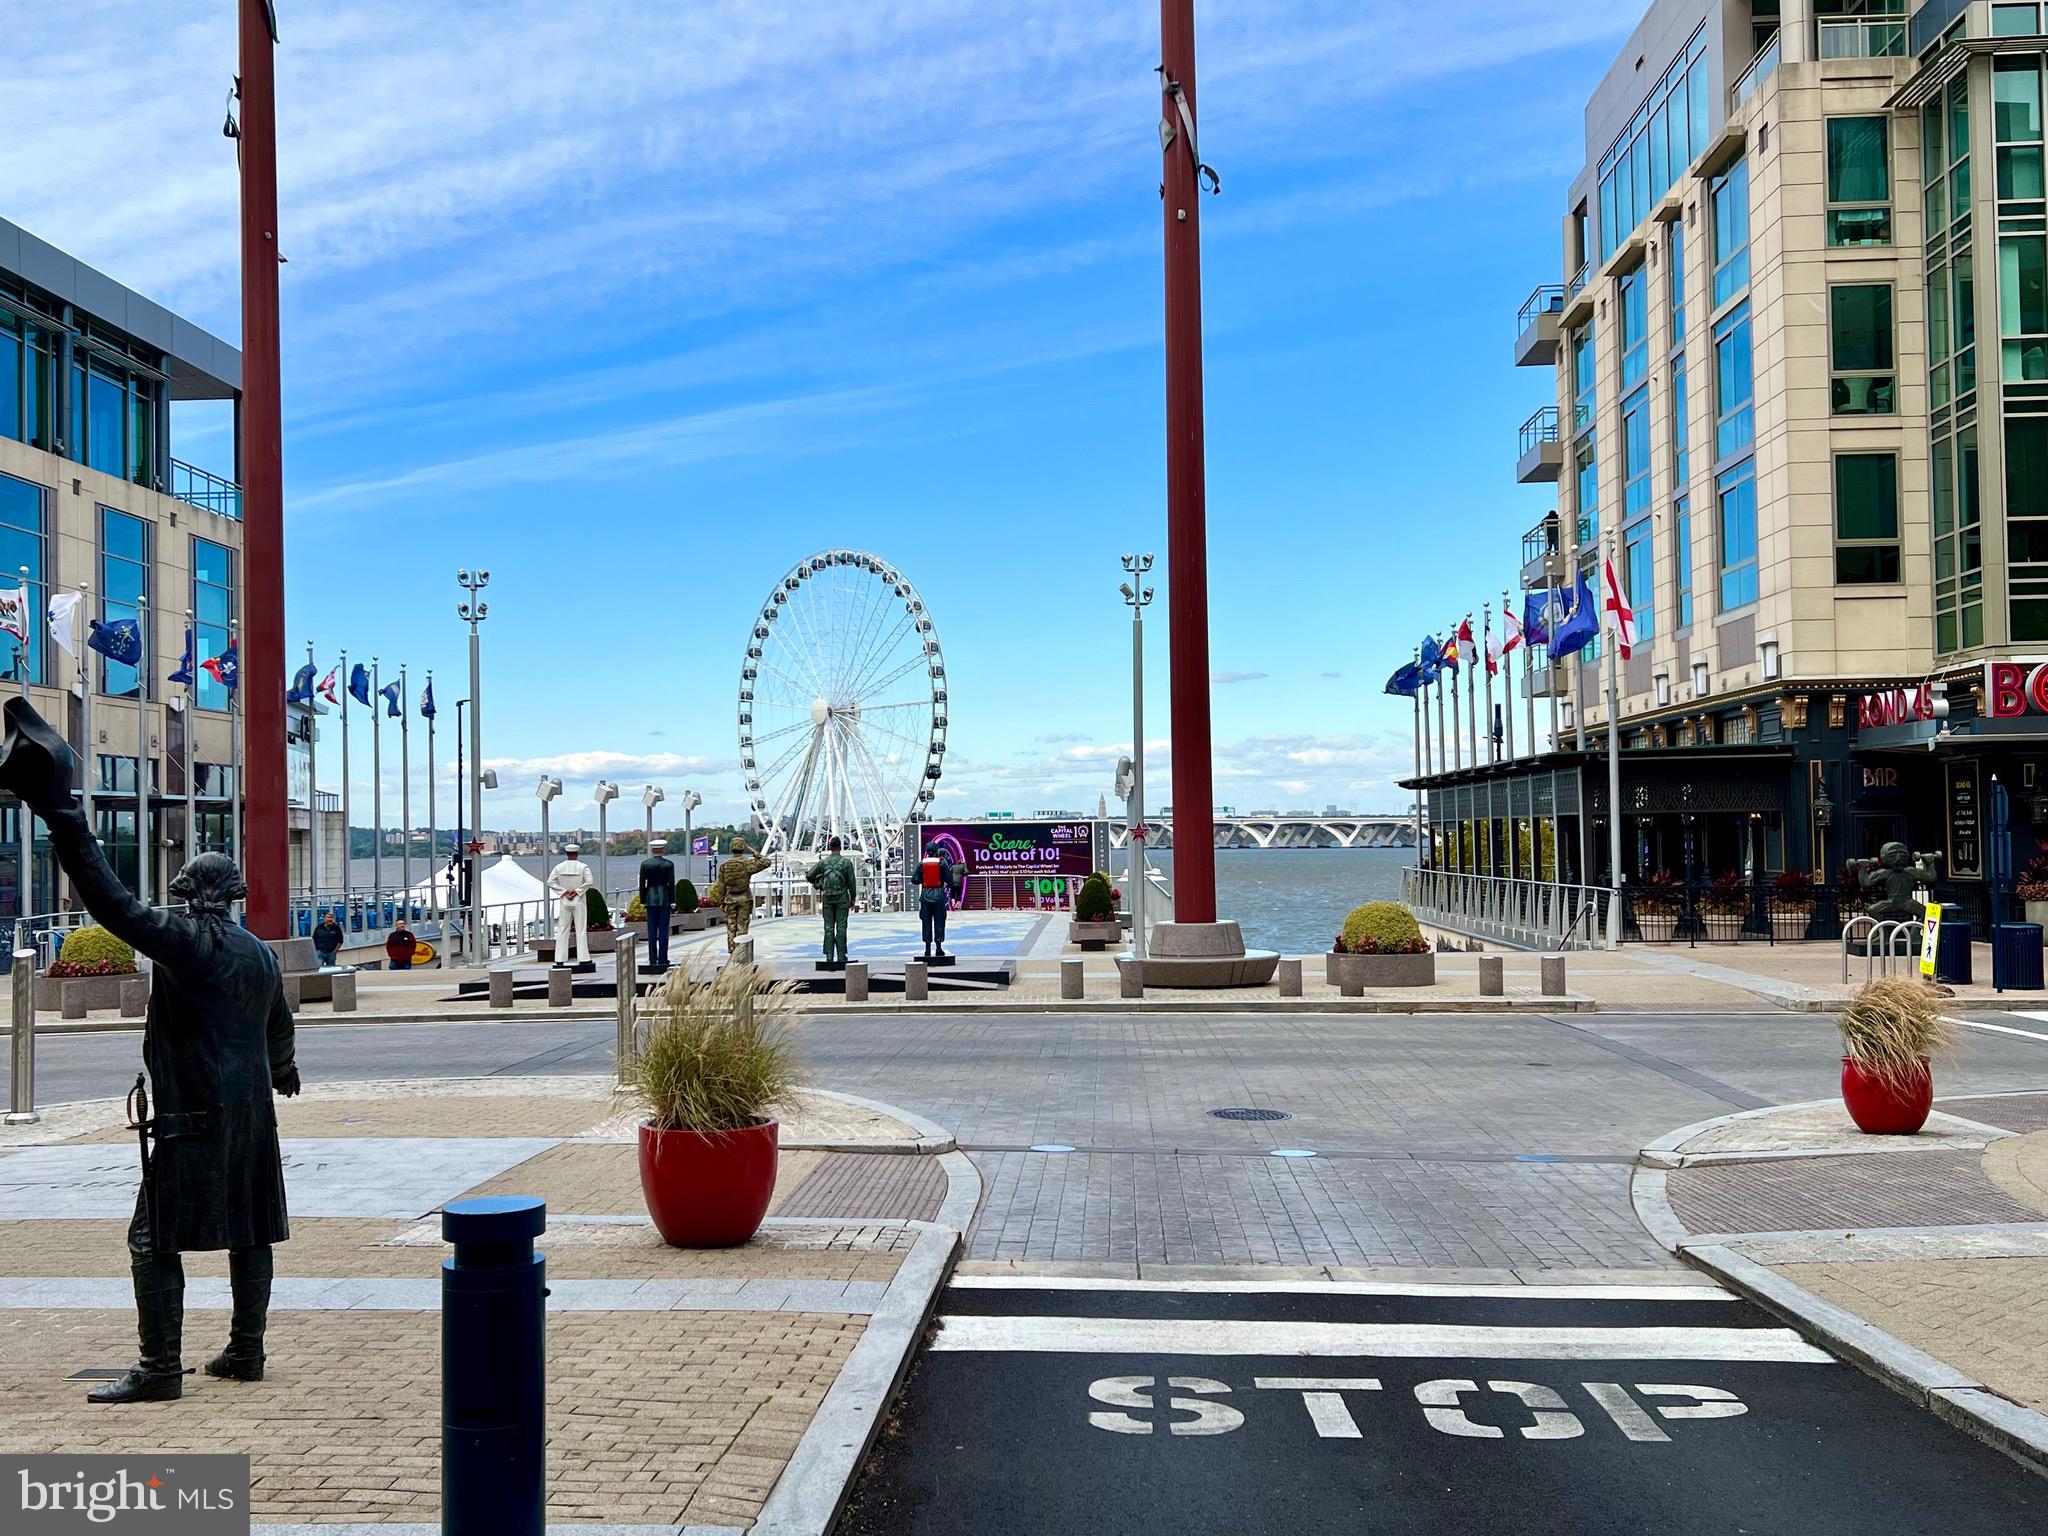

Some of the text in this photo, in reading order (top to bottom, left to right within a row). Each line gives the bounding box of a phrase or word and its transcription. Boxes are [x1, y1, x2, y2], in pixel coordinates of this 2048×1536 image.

[1858, 683, 1937, 729] BOND 45
[1863, 767, 1898, 787] BAR
[973, 847, 1060, 862] 10 out of 10!
[1024, 878, 1065, 894] $100
[1087, 1375, 1750, 1441] STOP
